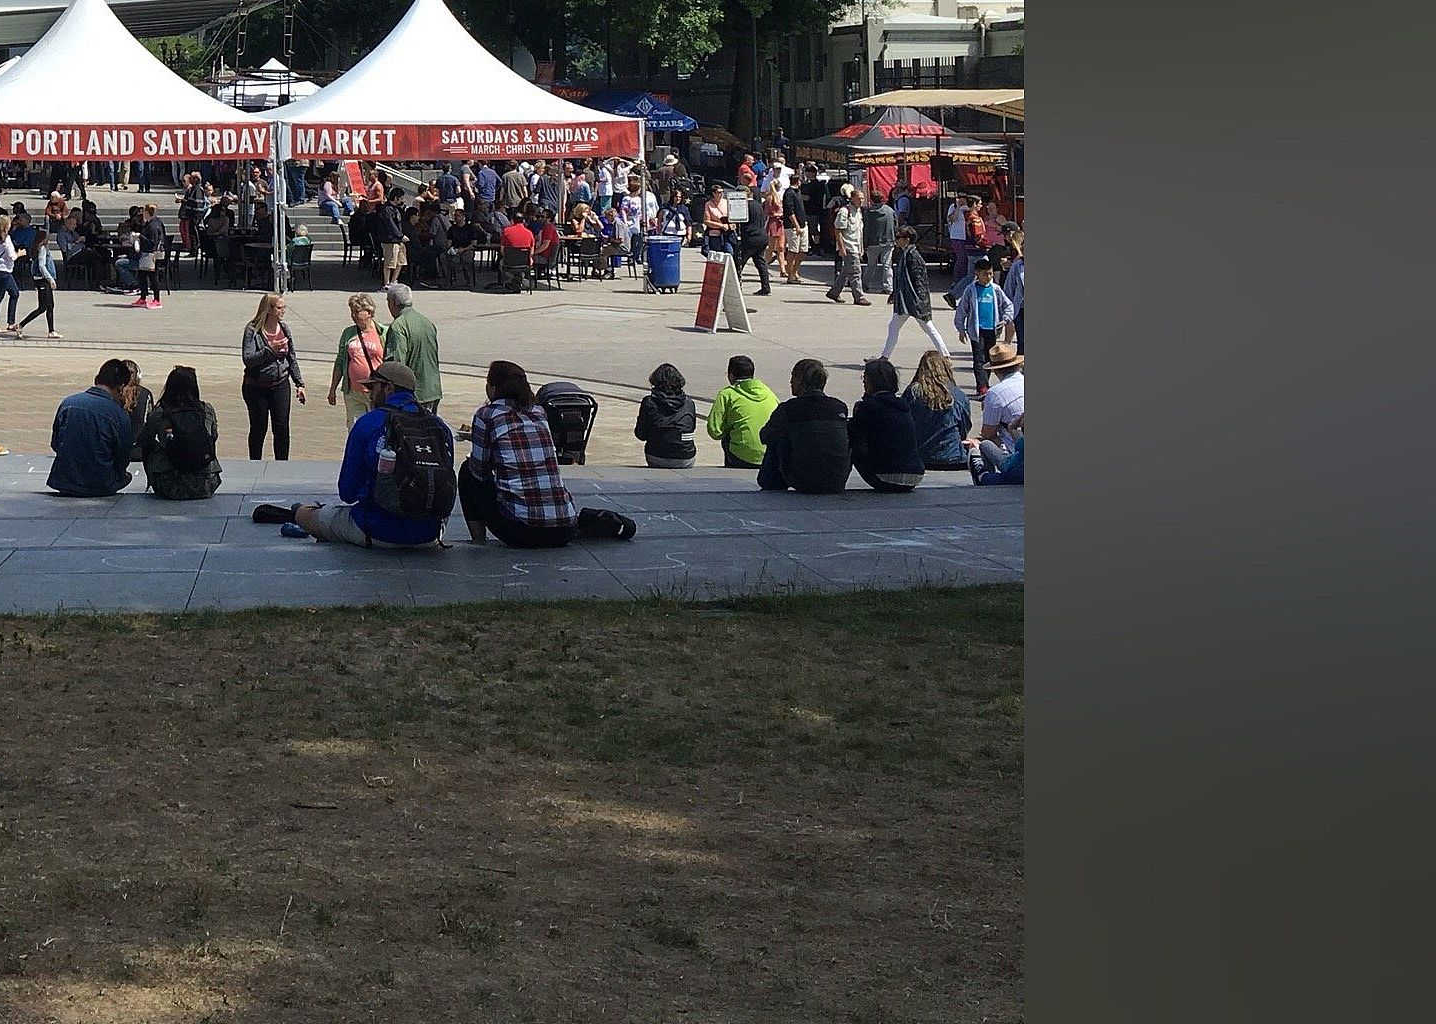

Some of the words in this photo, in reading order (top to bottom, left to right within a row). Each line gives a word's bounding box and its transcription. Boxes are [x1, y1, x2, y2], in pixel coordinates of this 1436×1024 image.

[659, 120, 684, 128] EARS
[10, 129, 135, 155] PORTLAND
[143, 128, 267, 155] SATURDAY
[296, 128, 397, 155] MARKET
[441, 129, 518, 144] SATURDAYS
[523, 129, 533, 144] &
[537, 127, 599, 144] SUNDAYS
[471, 144, 500, 155] MARCH
[506, 143, 554, 155] CHRISTMAS
[555, 143, 571, 154] EVE
